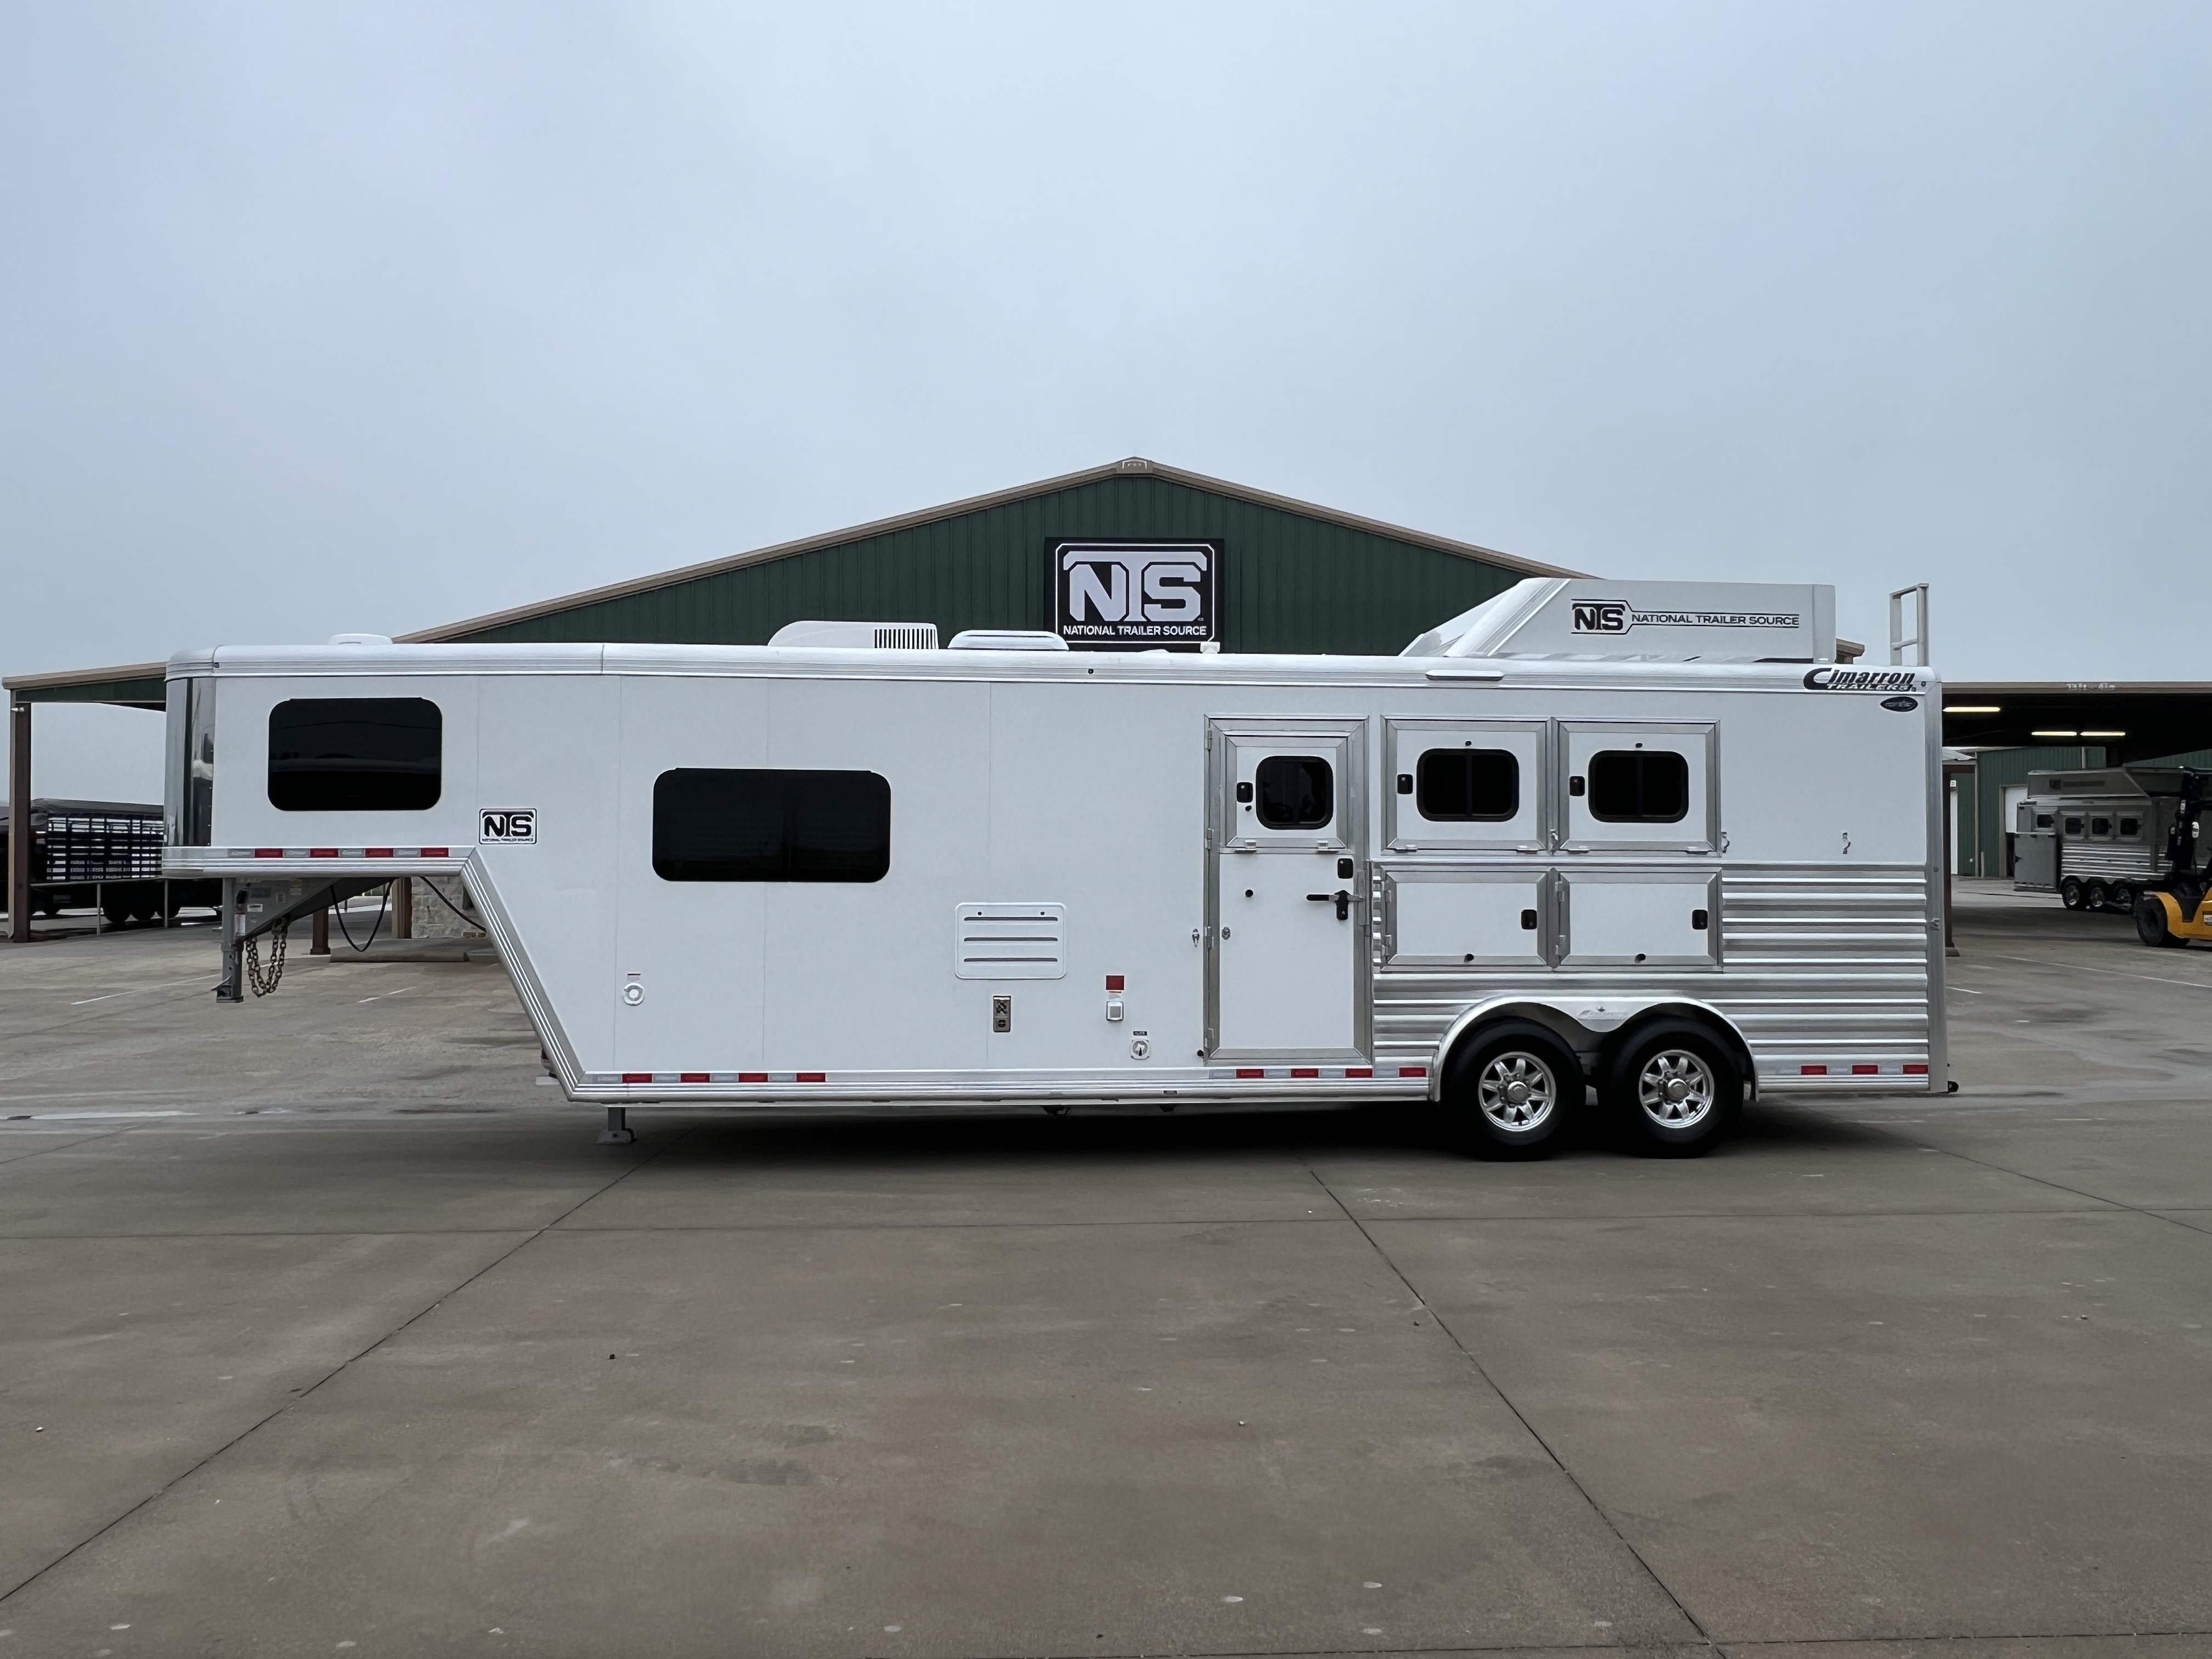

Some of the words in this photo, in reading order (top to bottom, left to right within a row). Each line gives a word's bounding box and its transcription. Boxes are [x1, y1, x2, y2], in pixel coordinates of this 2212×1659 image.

[1063, 551, 1207, 622] NTS
[1572, 603, 1626, 630] NTS
[1632, 613, 1693, 623] NATIONAL
[1695, 614, 1746, 625] TRAILER
[1748, 616, 1799, 625] SOURCE
[1063, 625, 1115, 636] NATIONAL
[1117, 625, 1161, 636] TRAILER
[1163, 625, 1207, 636] SOURCE
[1803, 668, 1915, 690] Cimarron
[482, 811, 534, 837] NTS
